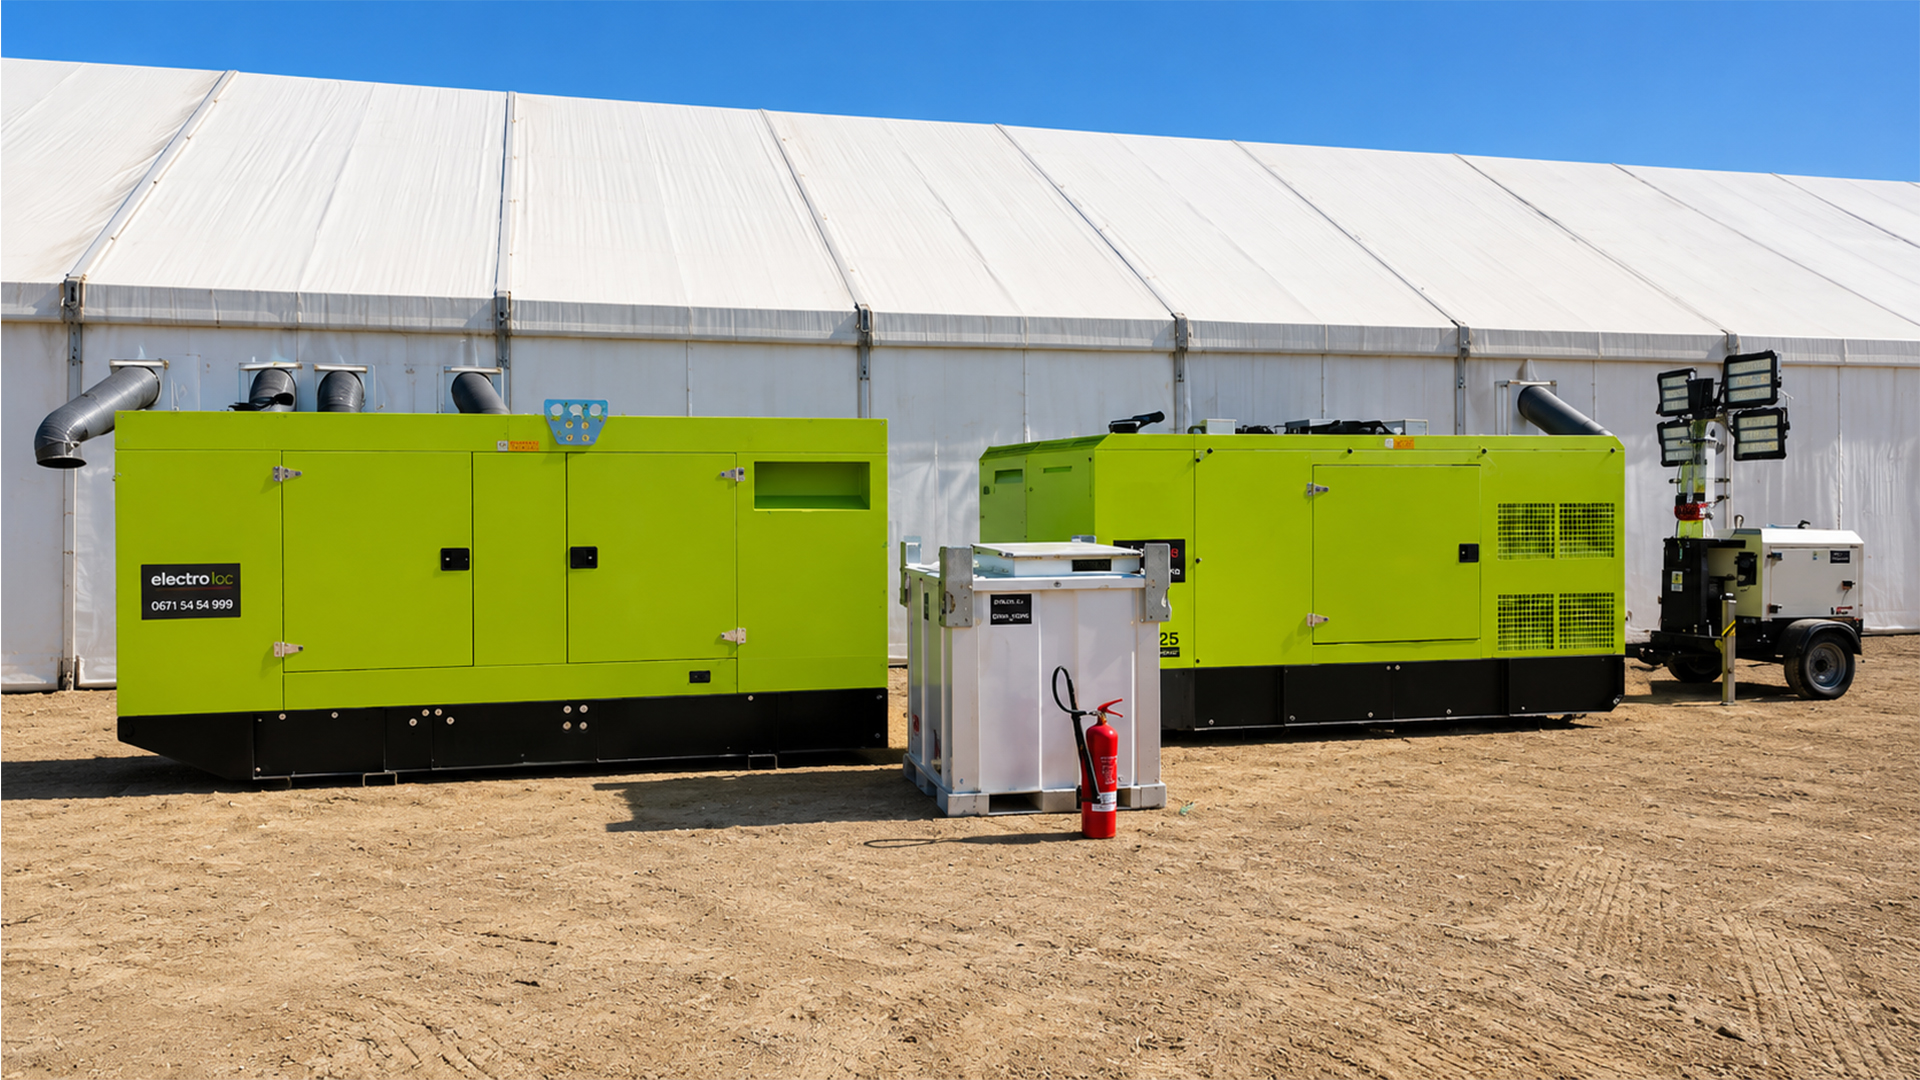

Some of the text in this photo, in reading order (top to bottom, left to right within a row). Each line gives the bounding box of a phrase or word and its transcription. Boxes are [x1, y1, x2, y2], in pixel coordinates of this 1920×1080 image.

[151, 571, 234, 586] electro loc
[151, 599, 234, 611] 0671 54 54 999
[1160, 632, 1179, 646] 25
